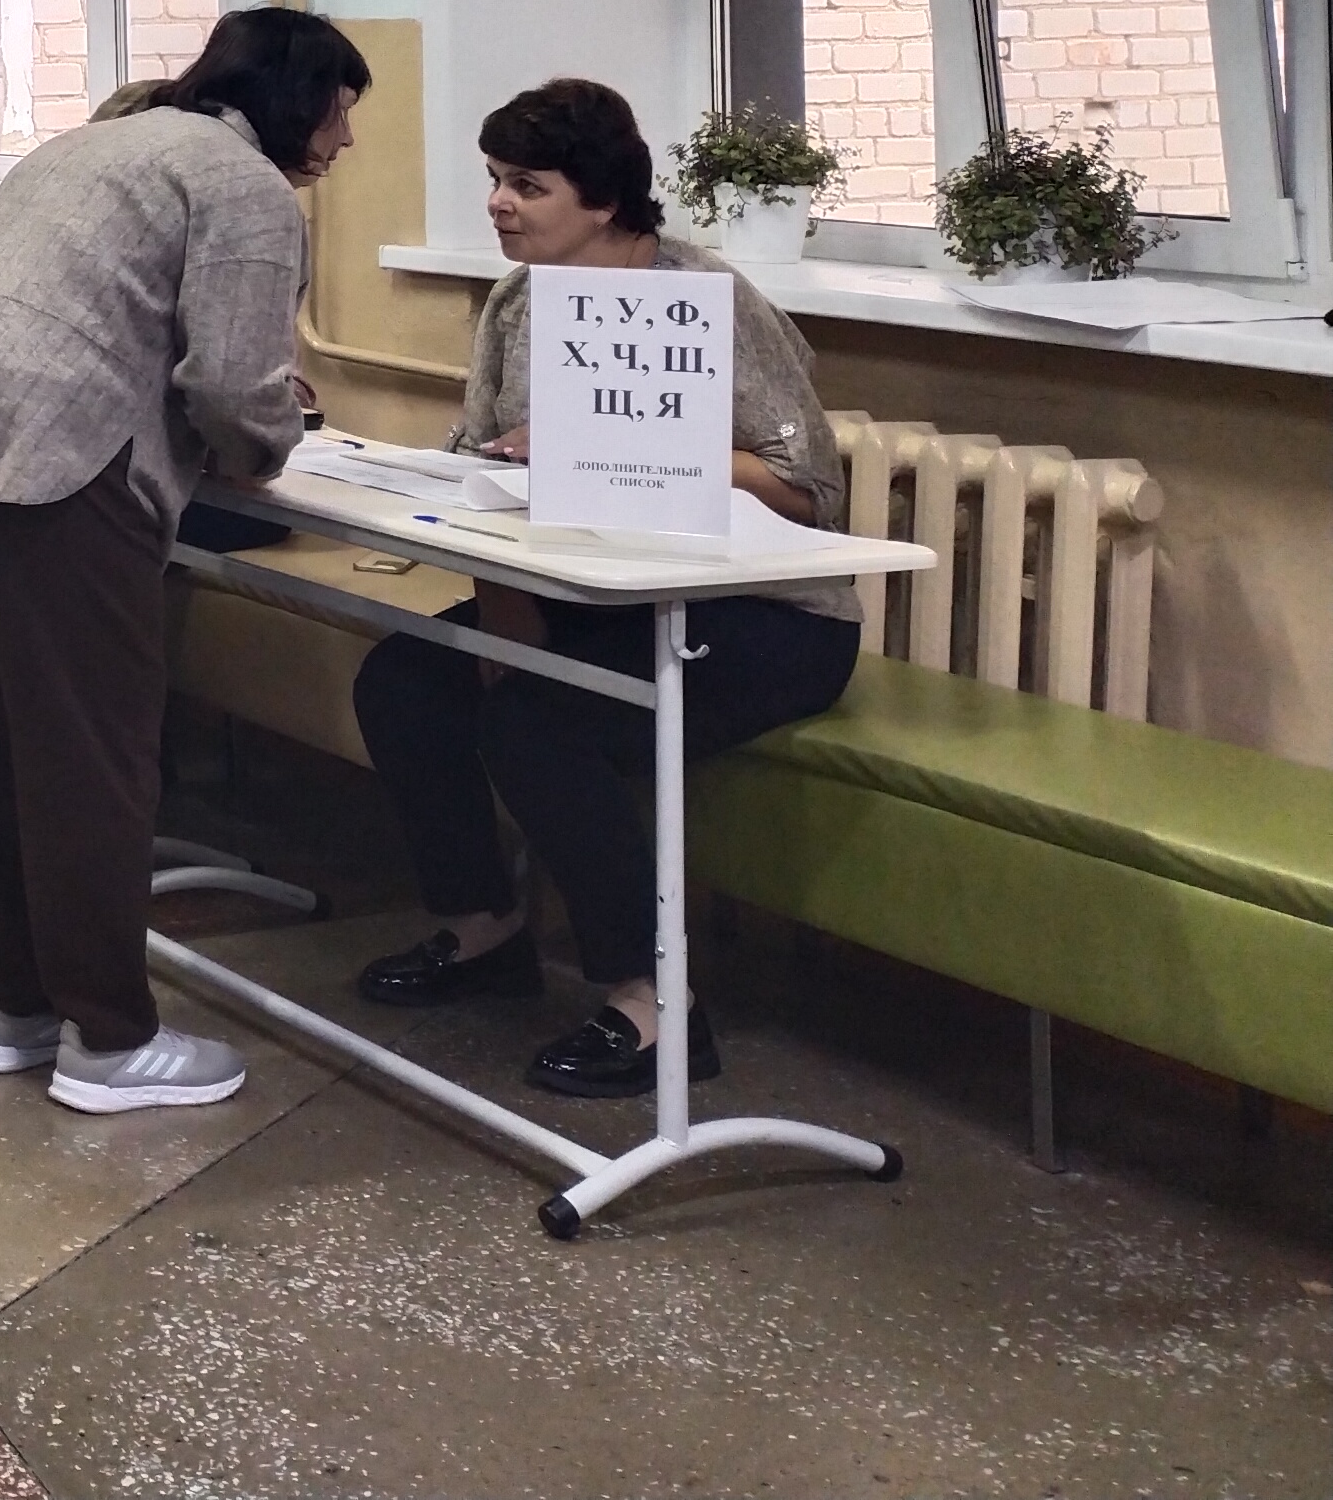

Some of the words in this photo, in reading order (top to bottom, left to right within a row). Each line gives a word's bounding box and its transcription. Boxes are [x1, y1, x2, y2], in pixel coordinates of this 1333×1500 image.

[568, 295, 604, 328] Т,
[615, 297, 654, 331] У,
[666, 300, 710, 333] Ф,
[562, 340, 600, 373] Х,
[611, 343, 650, 376] Ч,
[662, 346, 716, 380] Ш,
[592, 387, 645, 422] Щ,
[655, 392, 685, 419] Я
[573, 460, 704, 478] ДОПОЛНИТЕЛЬНЫЙ
[609, 477, 666, 490] СПИСОК
